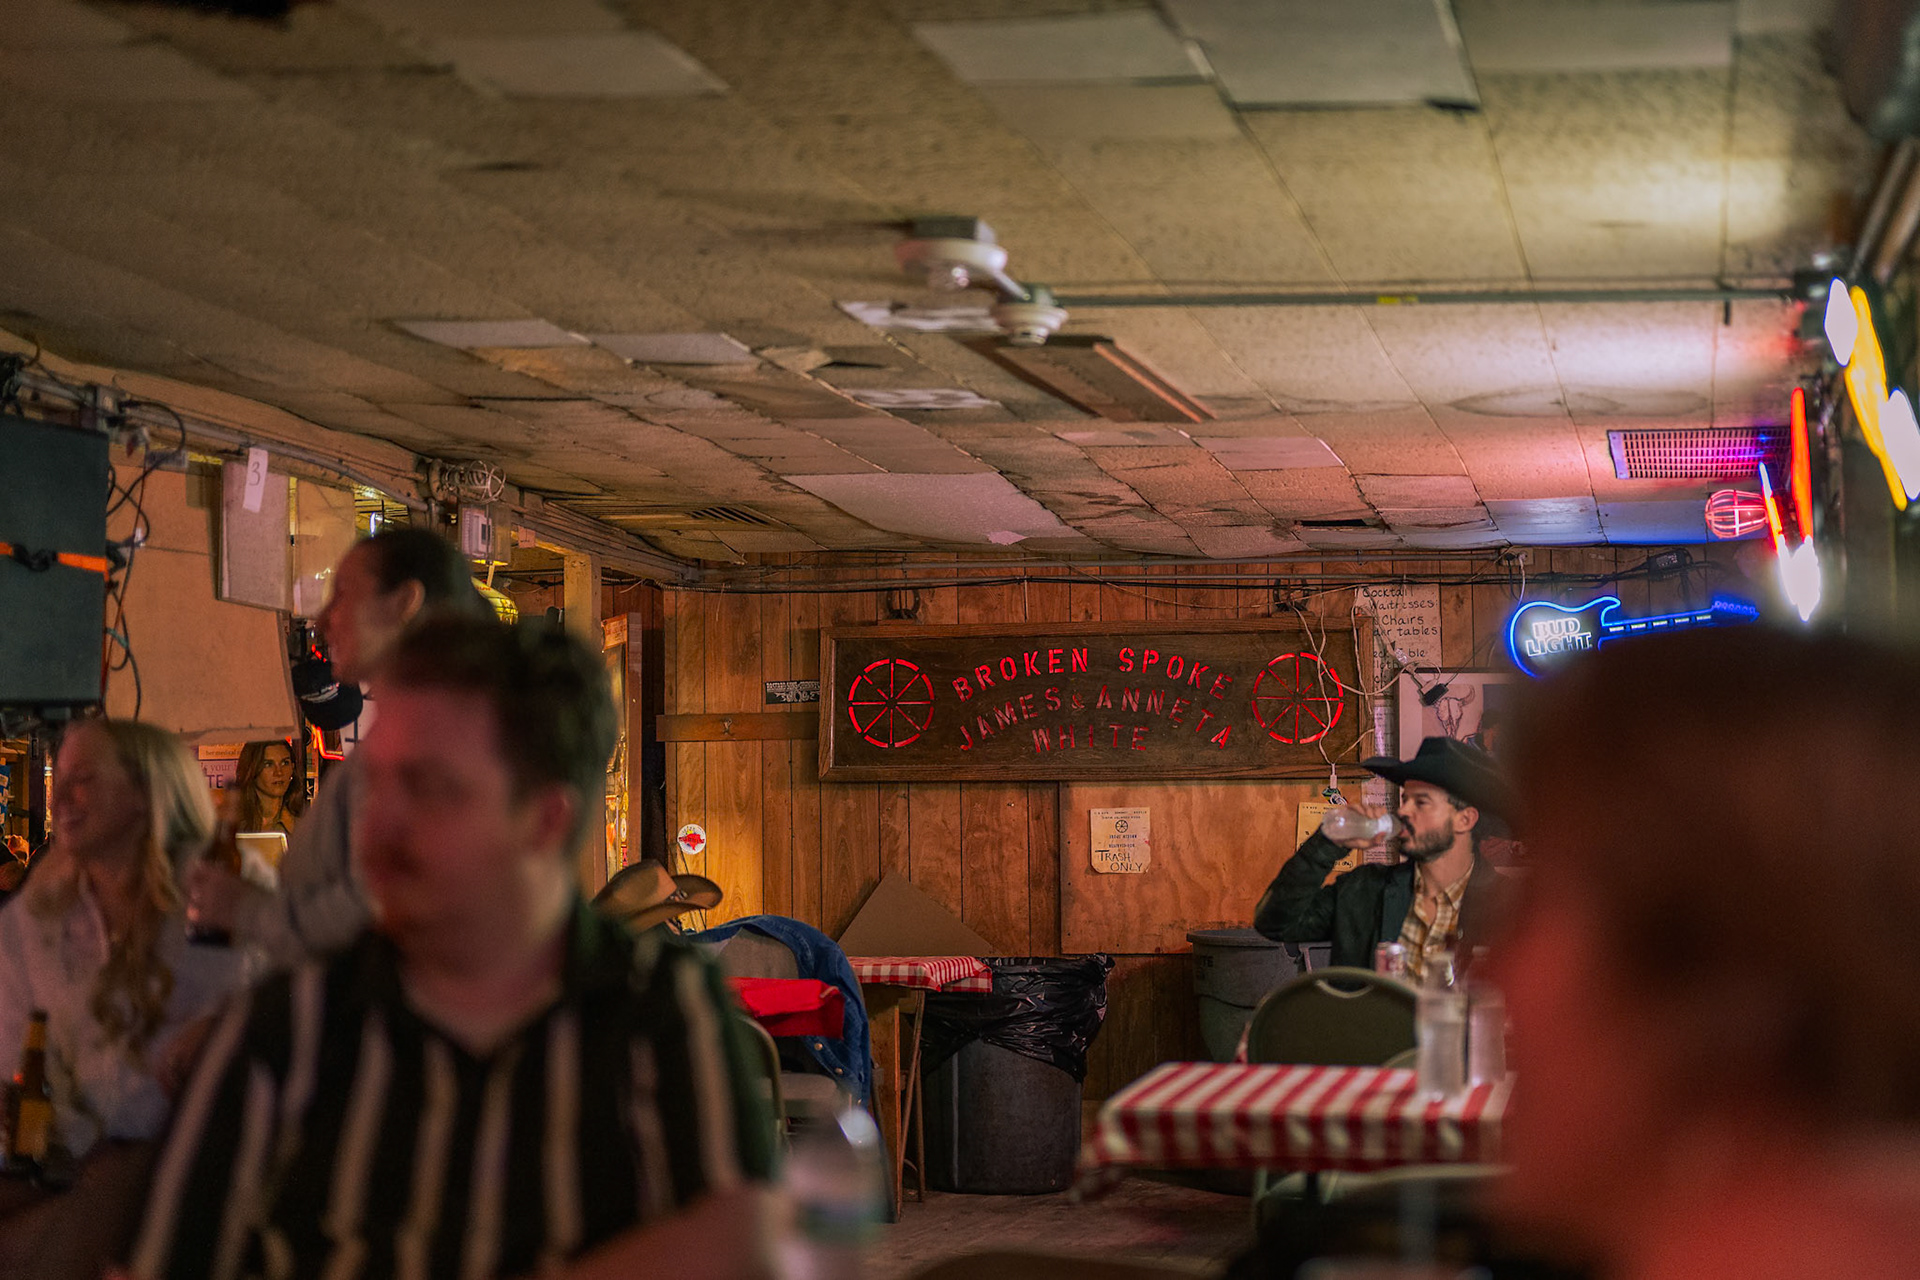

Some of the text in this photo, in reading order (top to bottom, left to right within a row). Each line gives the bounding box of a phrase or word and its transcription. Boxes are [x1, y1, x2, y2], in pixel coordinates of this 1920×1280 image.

[248, 461, 261, 486] 3
[1381, 614, 1424, 626] Chairs
[1396, 626, 1438, 637] tables
[1532, 617, 1580, 638] BUD
[1525, 632, 1592, 657] LIGHT
[952, 647, 1233, 702] BROKEN SPOKE
[960, 685, 1232, 751] JAMES & ANNETA
[1031, 724, 1150, 753] WHITE
[1095, 849, 1131, 862] TRASH
[1110, 862, 1143, 872] ONLY
